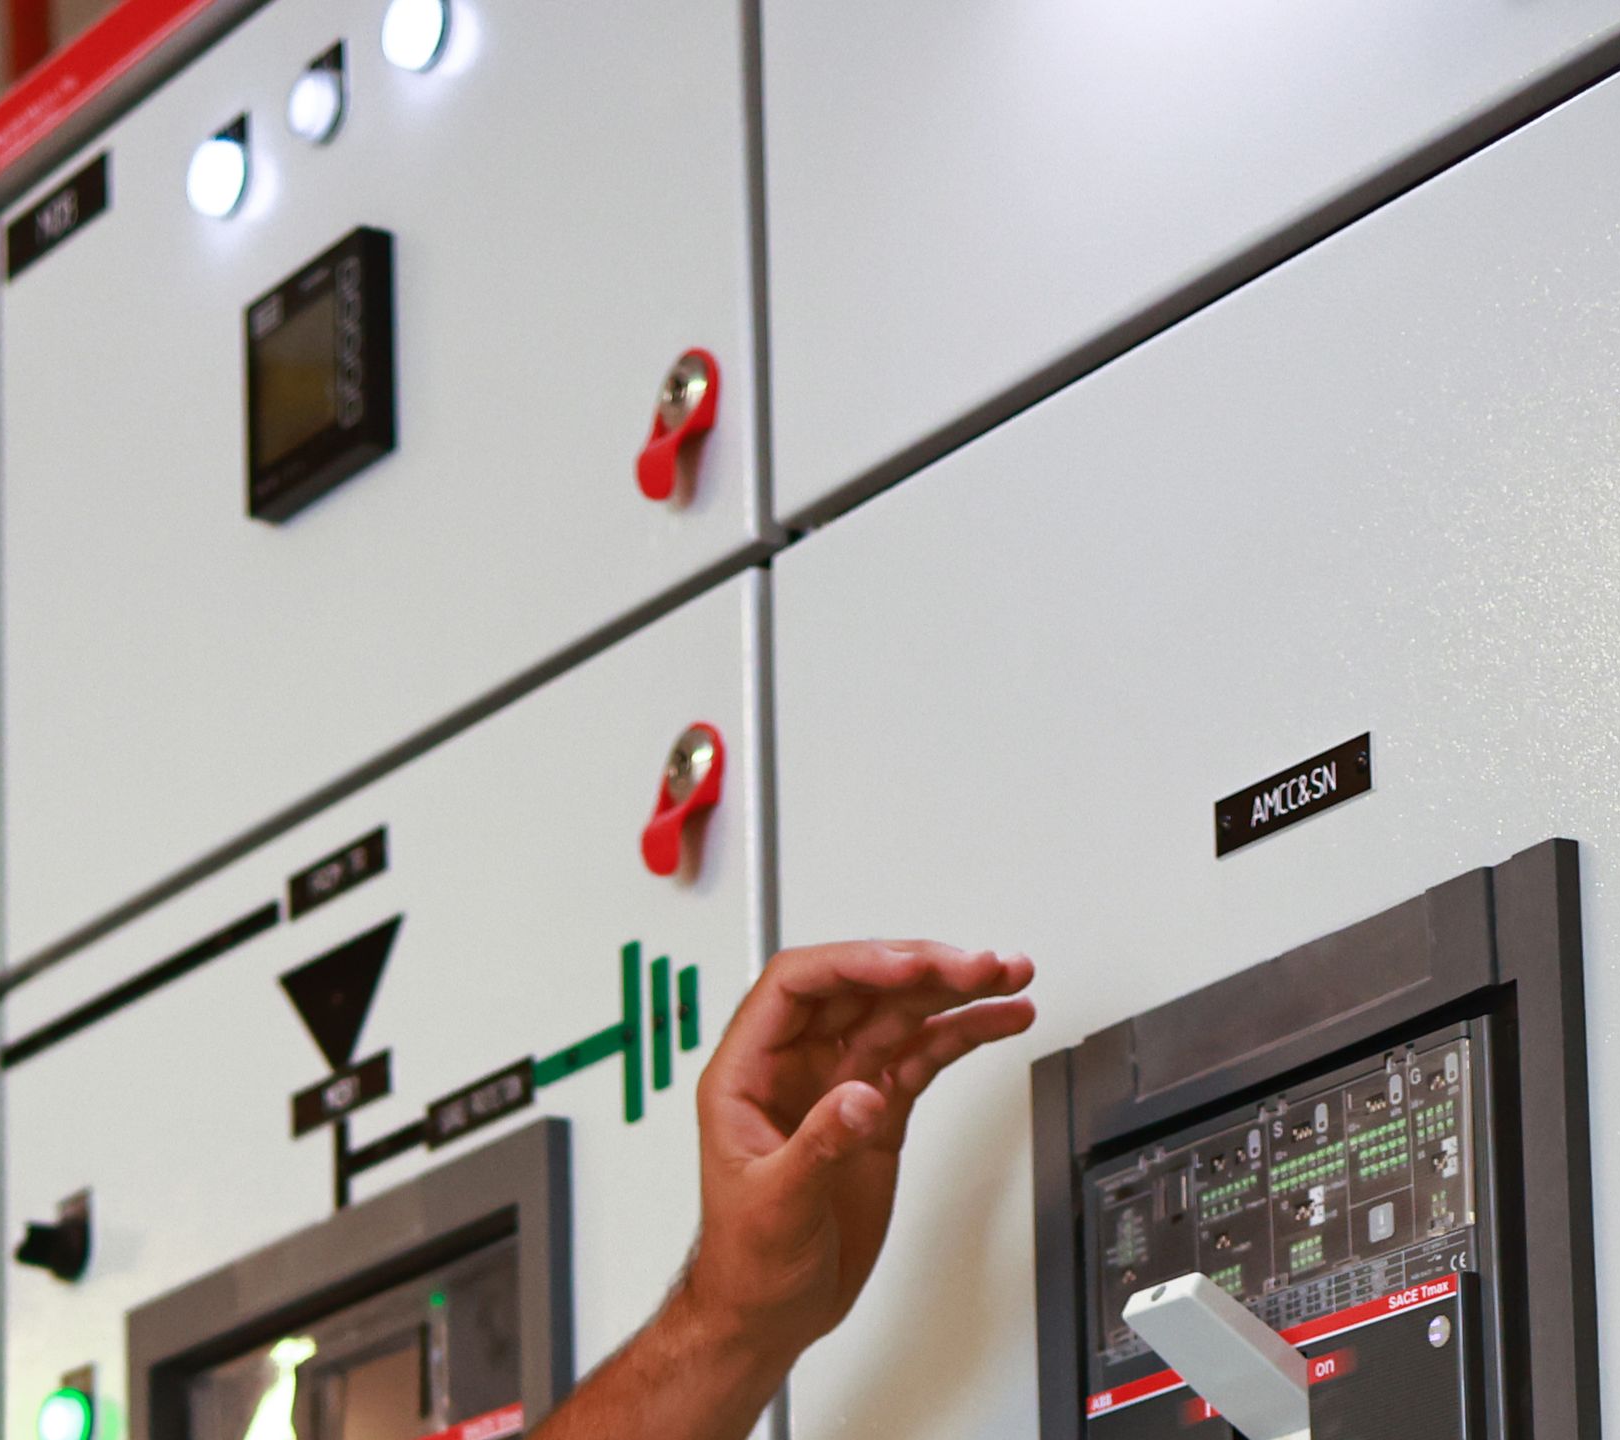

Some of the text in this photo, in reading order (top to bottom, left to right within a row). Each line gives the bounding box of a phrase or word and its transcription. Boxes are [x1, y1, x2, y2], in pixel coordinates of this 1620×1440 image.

[1250, 760, 1337, 828] AMCC&SN
[1388, 1281, 1449, 1309] SACE Tmax
[1315, 1357, 1335, 1378] on
